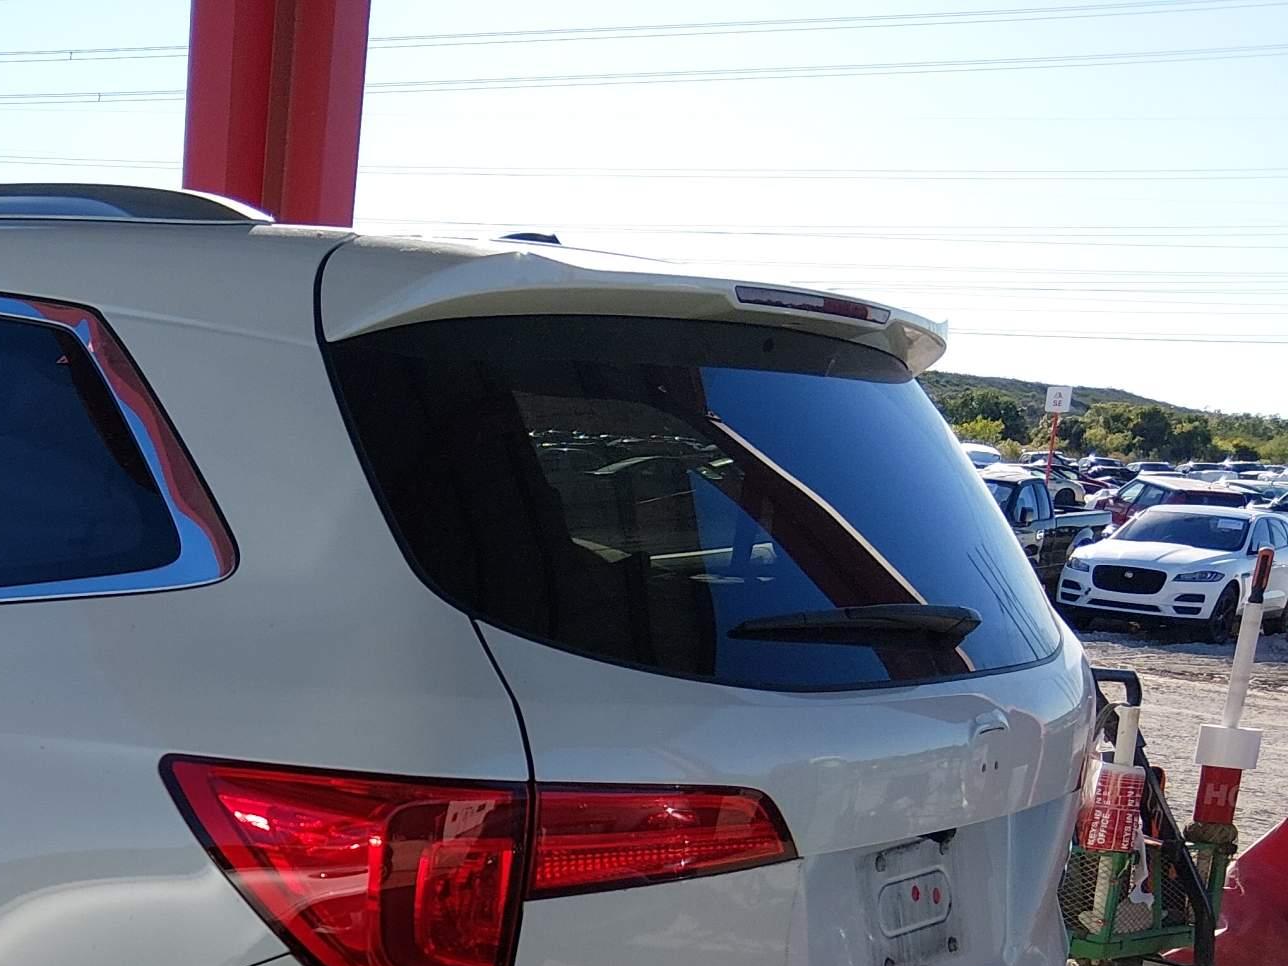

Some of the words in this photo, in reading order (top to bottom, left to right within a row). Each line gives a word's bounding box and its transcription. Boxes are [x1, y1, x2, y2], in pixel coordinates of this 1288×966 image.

[1087, 821, 1099, 846] KEYS
[1097, 812, 1111, 845] OFFICE
[1121, 825, 1133, 849] KEYS
